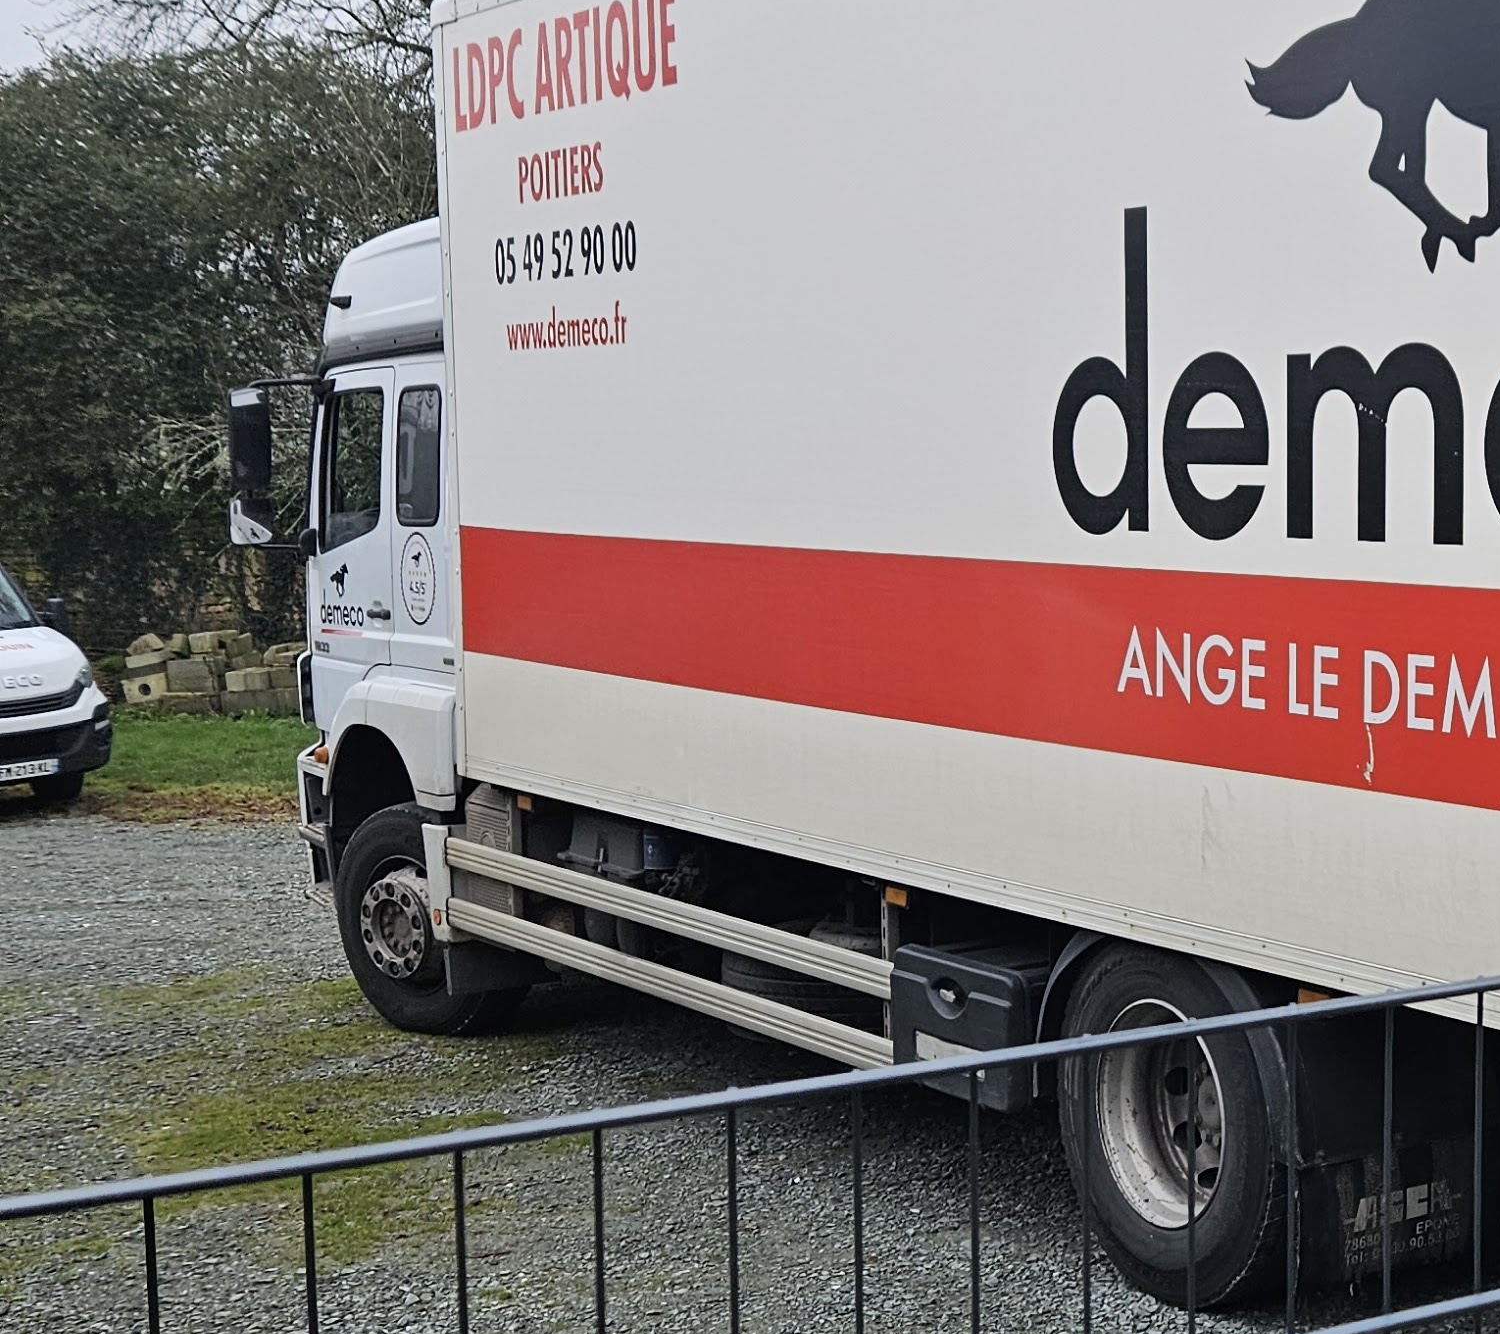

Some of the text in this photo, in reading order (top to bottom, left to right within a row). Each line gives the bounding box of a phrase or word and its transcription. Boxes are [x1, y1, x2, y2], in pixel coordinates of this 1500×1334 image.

[452, 28, 525, 133] LDPC
[518, 141, 604, 204] POITIERS
[495, 220, 637, 285] 05 49 52 90 00
[507, 299, 627, 351] www.demeco.fr
[320, 588, 364, 627] demeco
[1117, 624, 1267, 712] ANGE
[1287, 641, 1340, 720] LE
